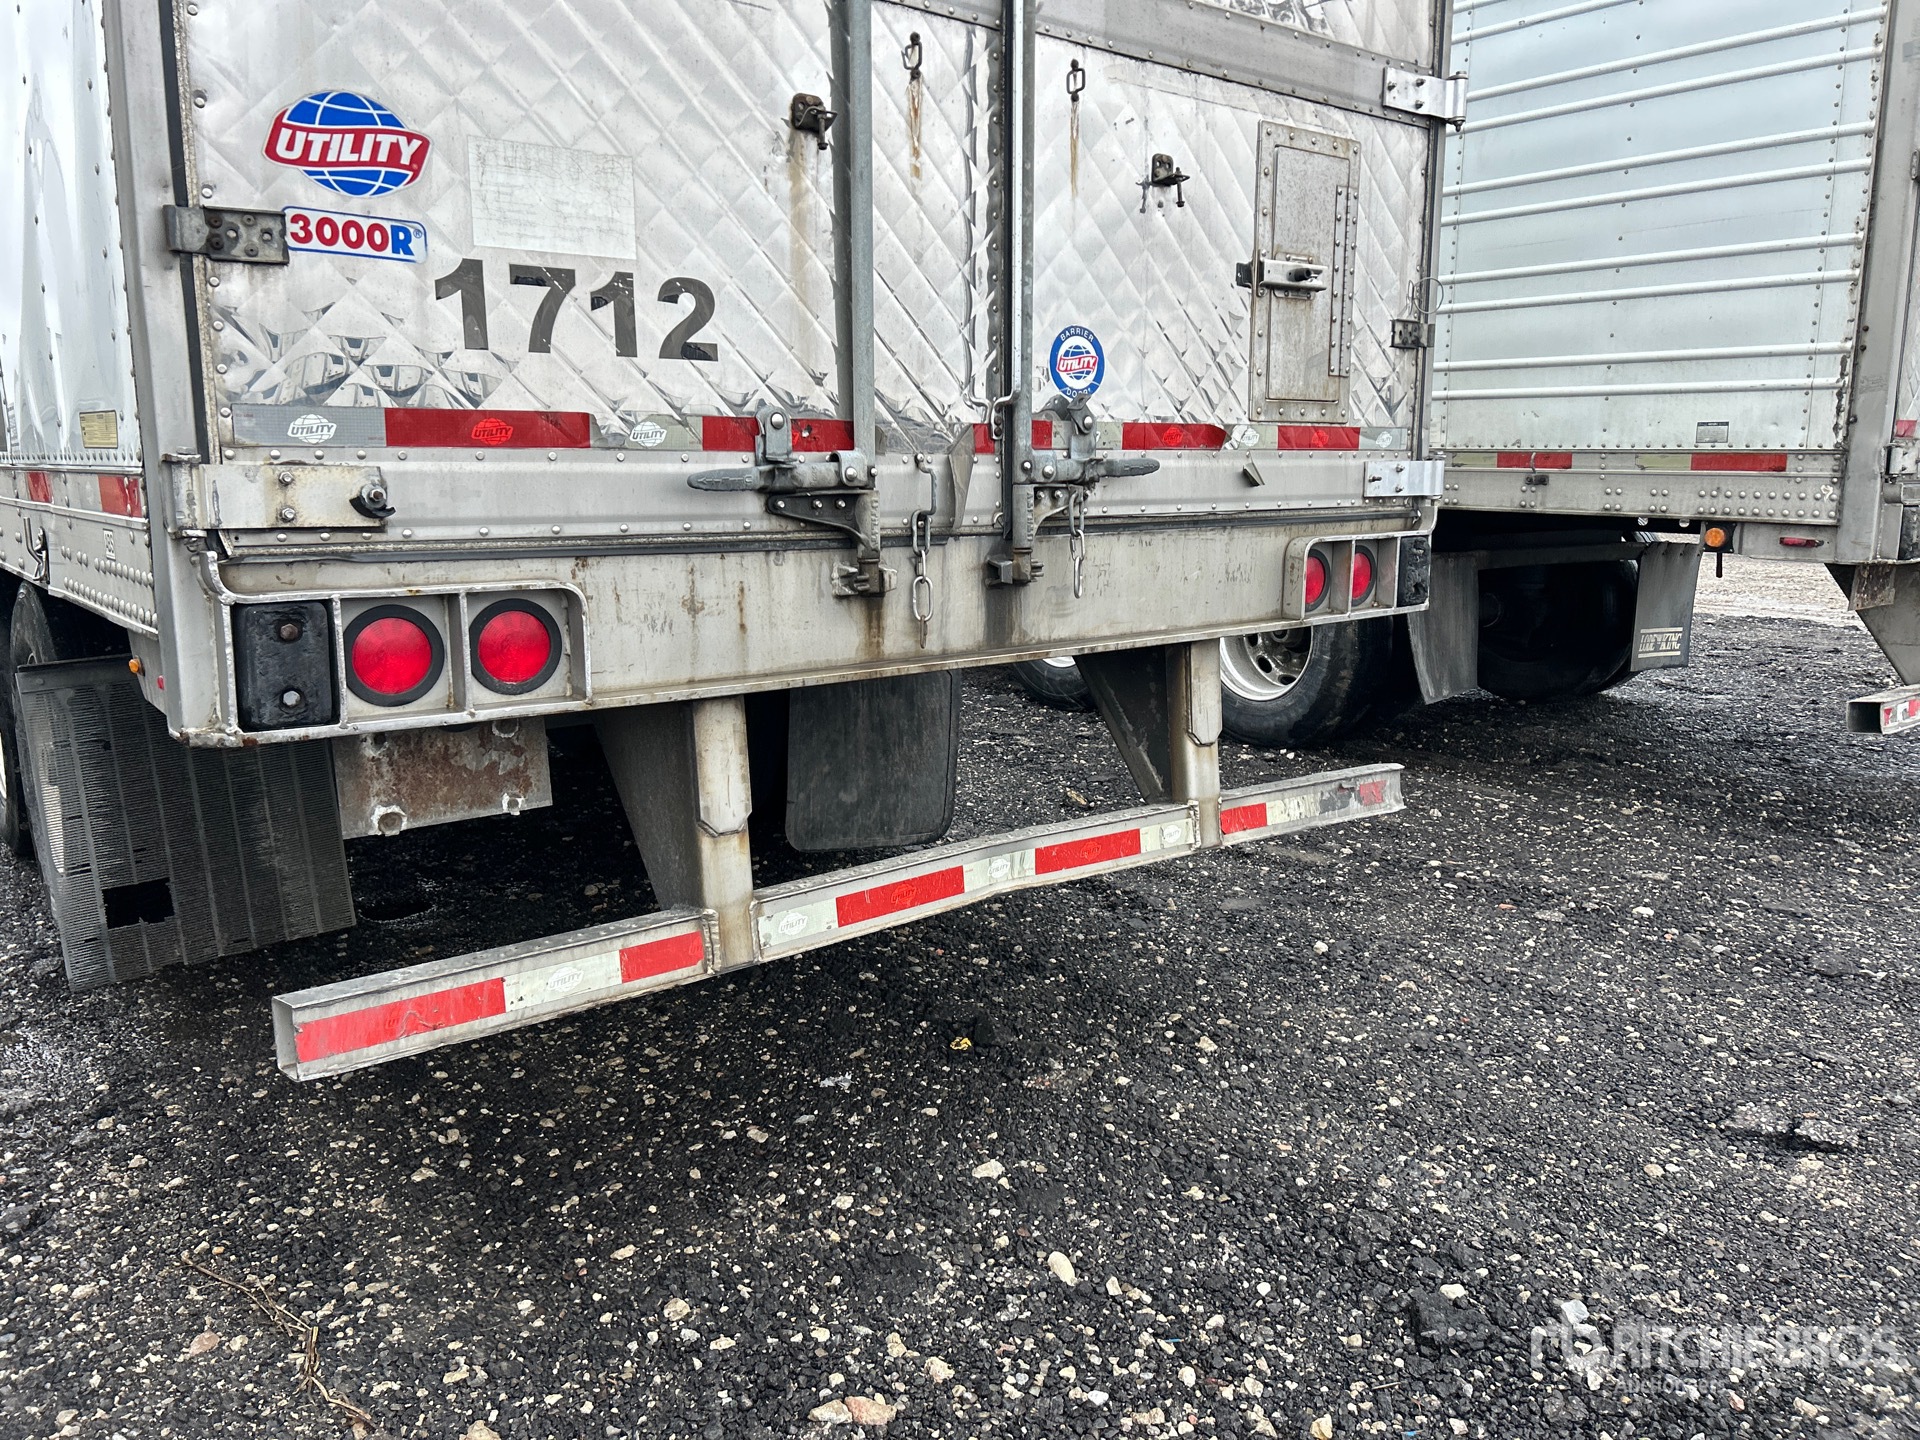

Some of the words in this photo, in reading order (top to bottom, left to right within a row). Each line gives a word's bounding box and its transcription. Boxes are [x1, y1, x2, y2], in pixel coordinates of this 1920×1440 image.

[275, 127, 423, 166] UTILITY
[434, 258, 719, 362] 1712
[1060, 327, 1094, 343] BARRIER
[1058, 356, 1096, 371] UTILITY
[291, 424, 333, 435] UTILITY
[473, 426, 512, 438] UTILITY
[632, 429, 665, 440] UTILITY
